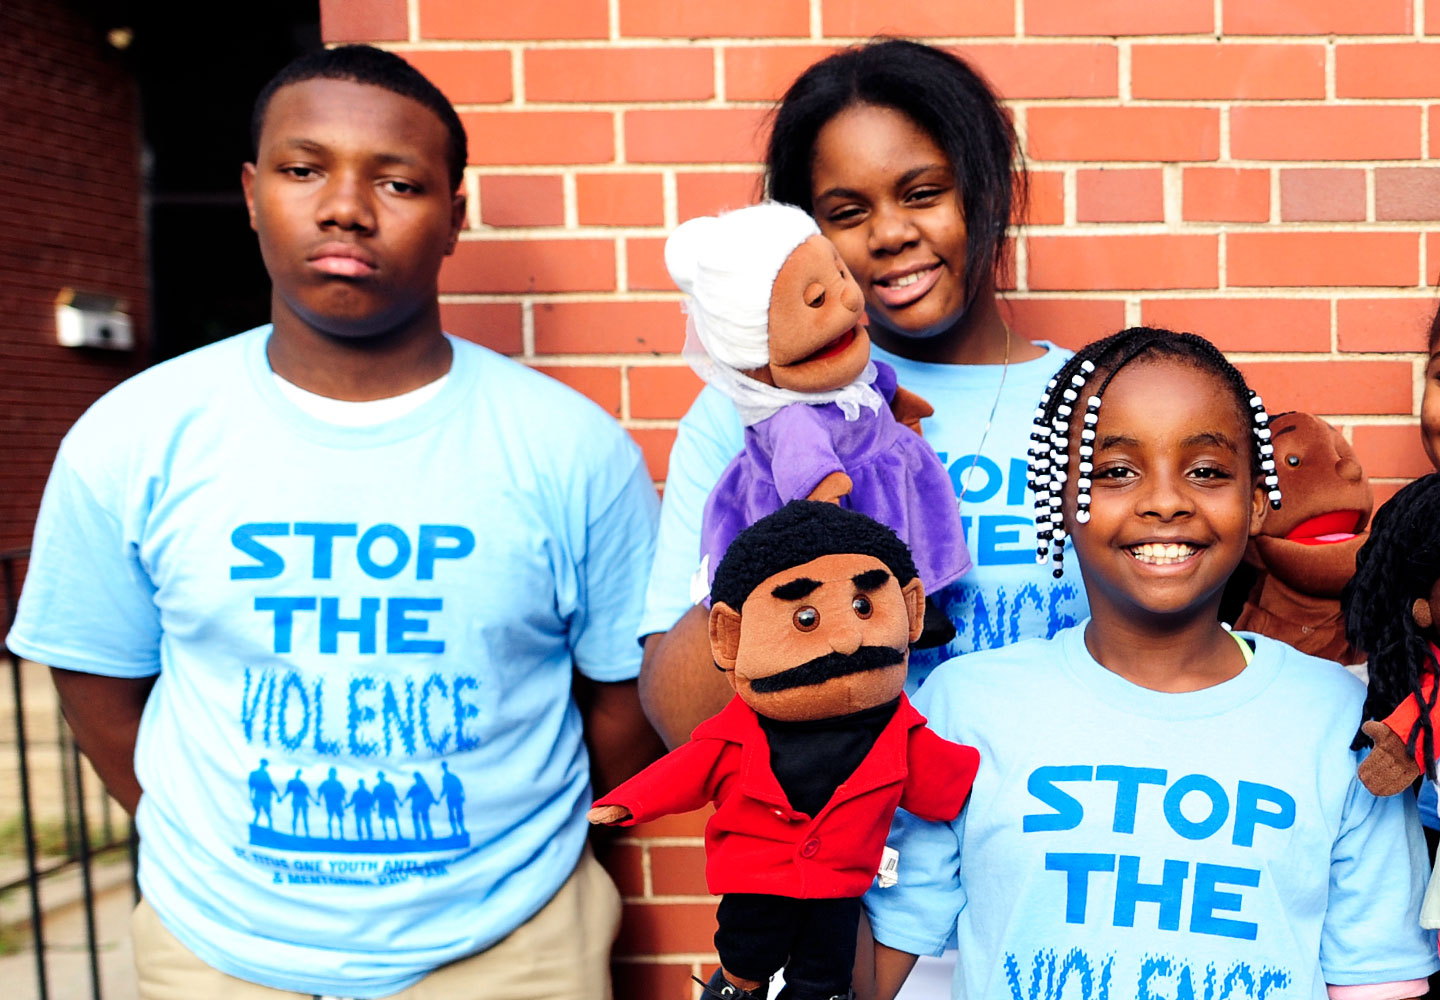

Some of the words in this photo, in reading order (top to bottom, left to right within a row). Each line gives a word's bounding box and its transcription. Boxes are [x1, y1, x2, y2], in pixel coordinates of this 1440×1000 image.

[230, 522, 476, 581] STOP
[254, 597, 445, 654] THE
[241, 667, 481, 757] VIOLENCE
[1023, 764, 1296, 848] STOP
[328, 860, 378, 874] YOUTH
[1045, 852, 1261, 941] THE
